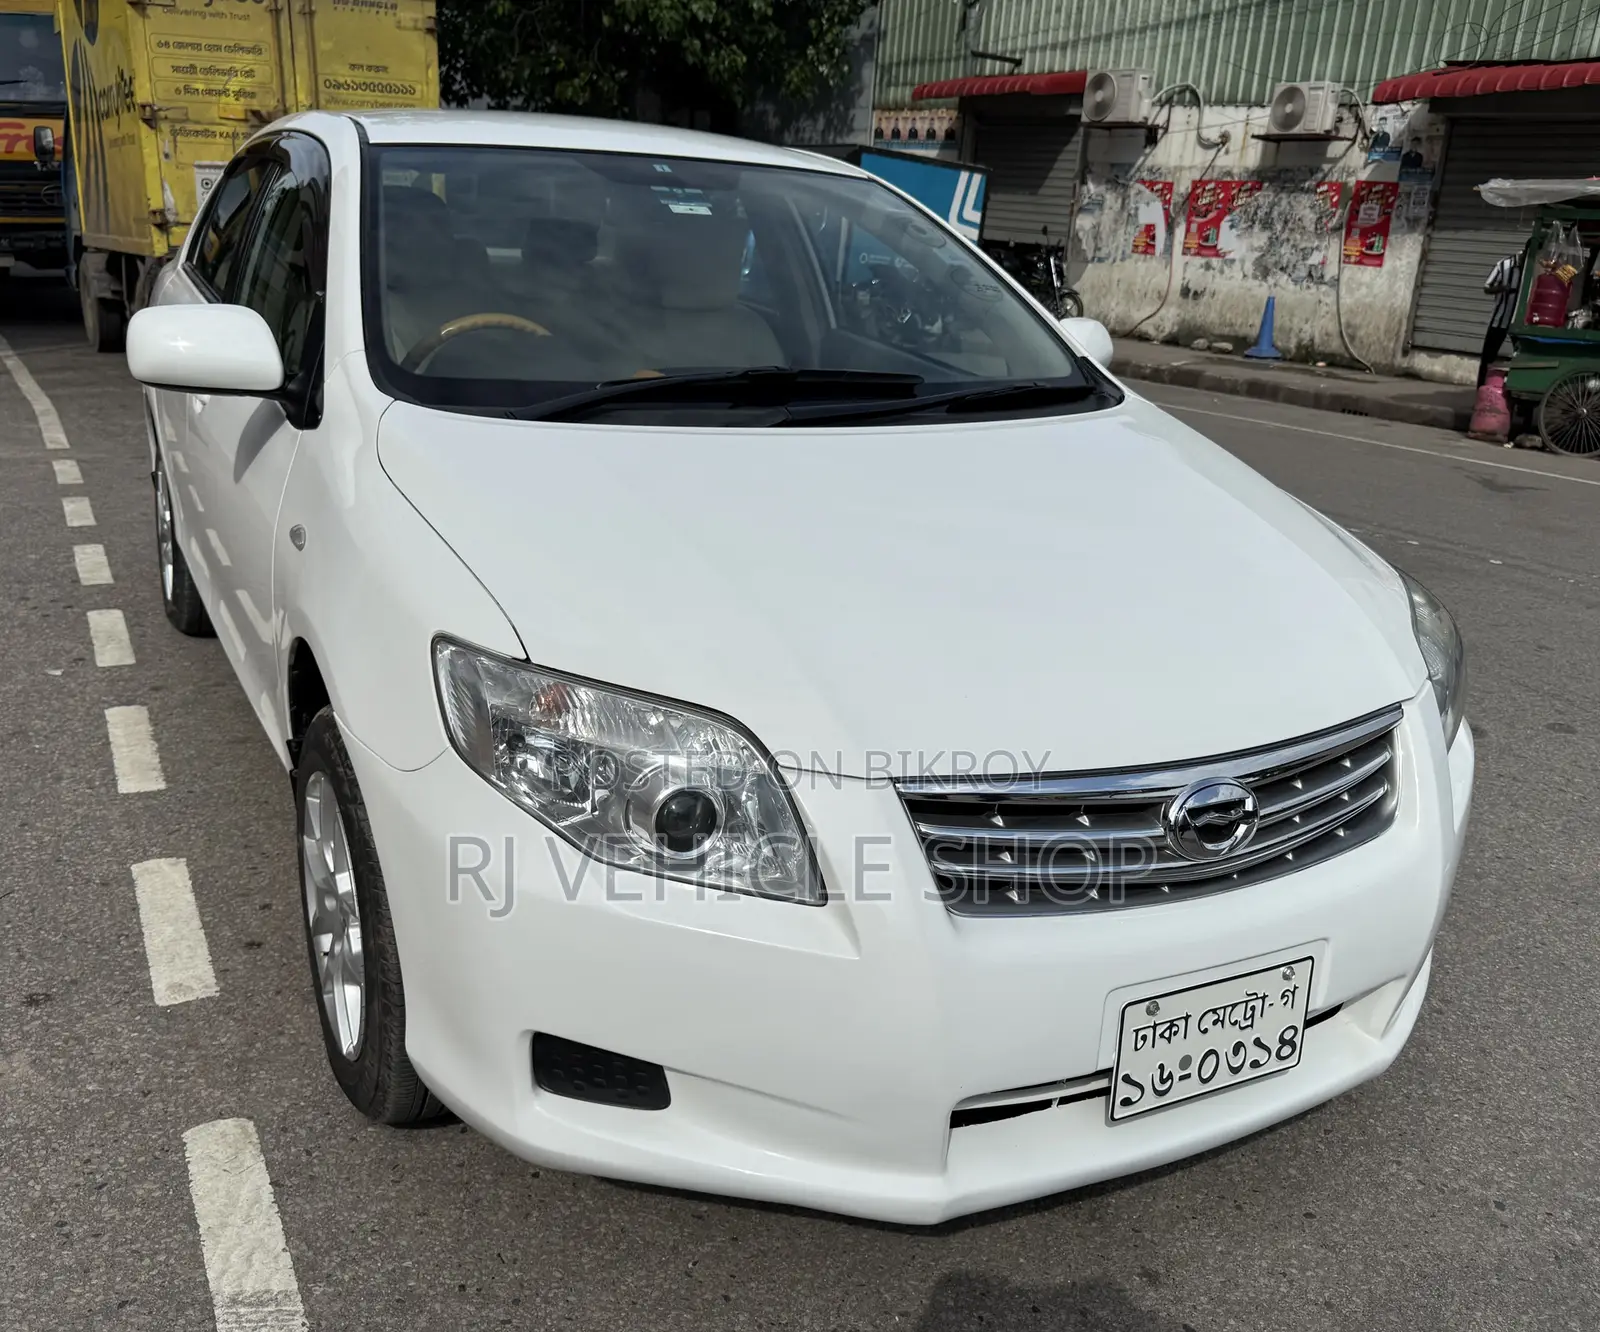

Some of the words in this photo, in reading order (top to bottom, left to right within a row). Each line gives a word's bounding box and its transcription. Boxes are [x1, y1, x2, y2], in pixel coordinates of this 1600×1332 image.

[208, 11, 227, 19] with
[229, 12, 250, 21] Trust
[1133, 1011, 1192, 1051] ঢাকা
[1119, 1024, 1299, 1107] ১৬-০৩১৪
